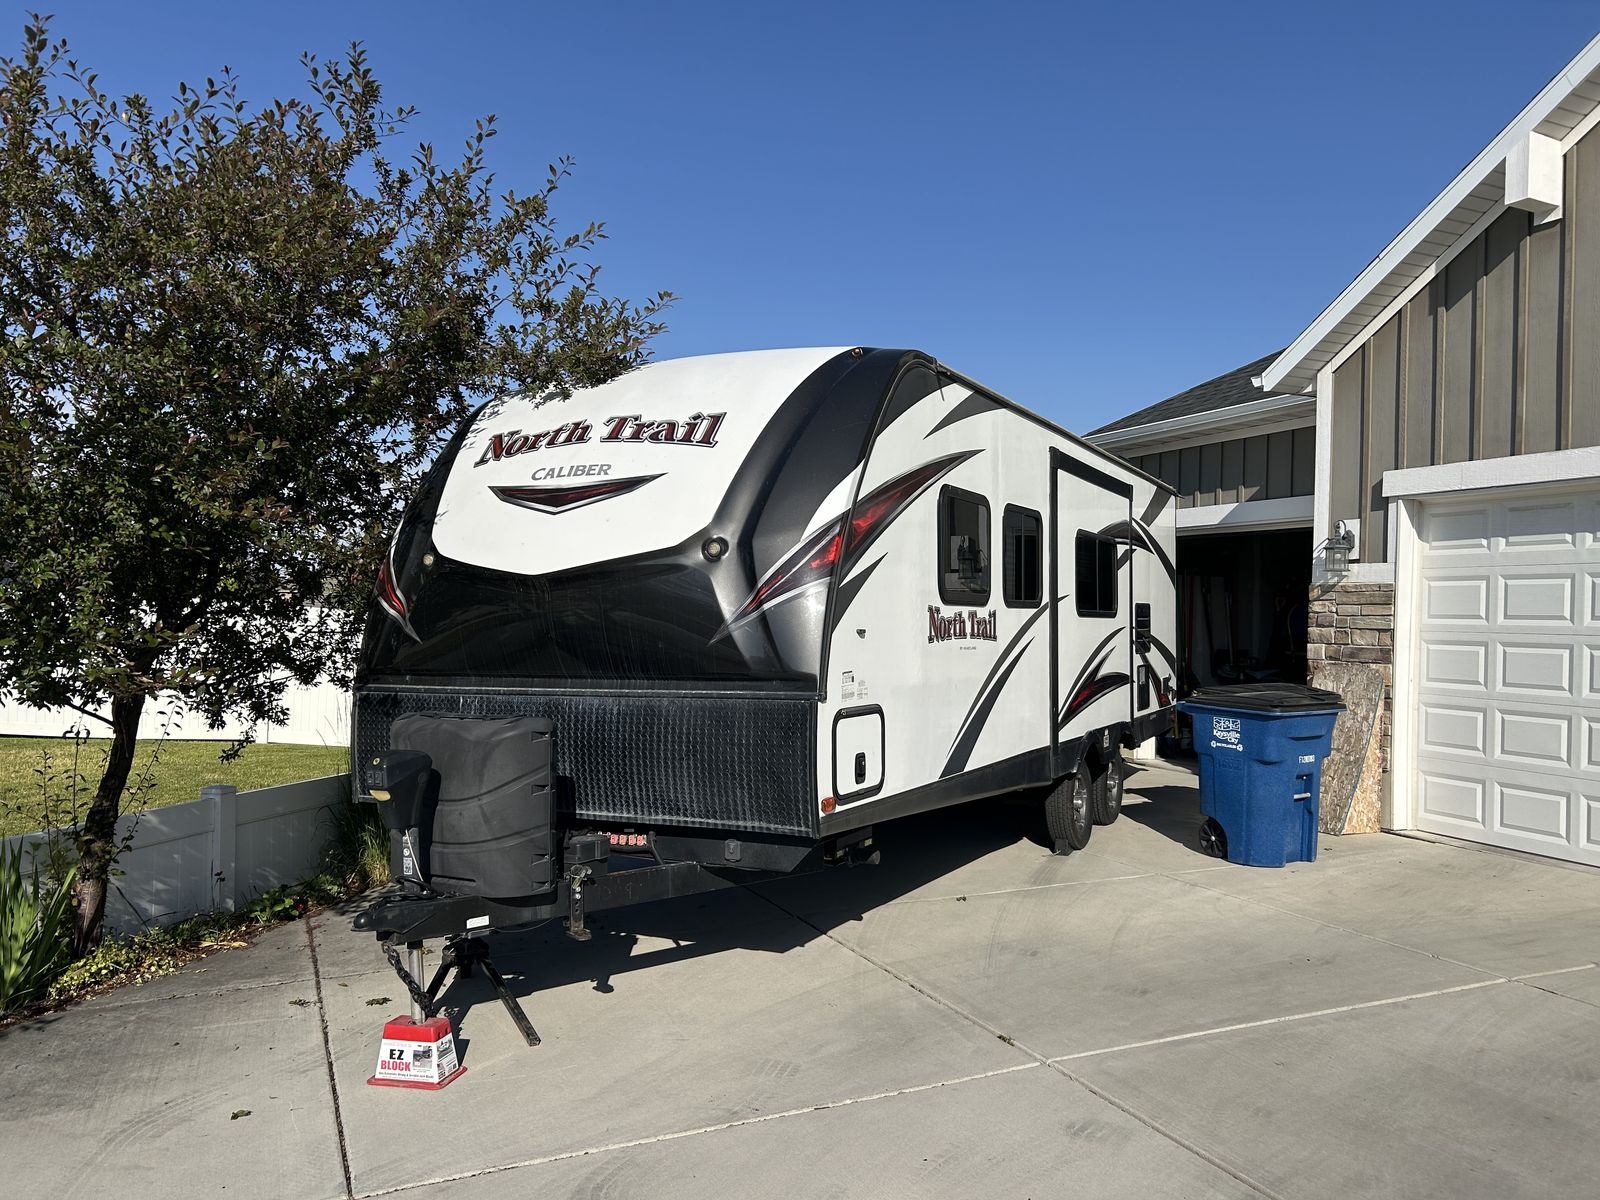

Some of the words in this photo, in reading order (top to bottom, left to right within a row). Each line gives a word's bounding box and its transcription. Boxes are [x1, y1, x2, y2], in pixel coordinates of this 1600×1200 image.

[473, 419, 592, 468] North
[600, 411, 727, 448] Trail
[531, 463, 612, 481] CALIBER
[928, 604, 967, 644] North
[967, 609, 997, 642] Trail
[389, 1049, 405, 1060] EZ
[380, 1060, 411, 1072] BLOCK
